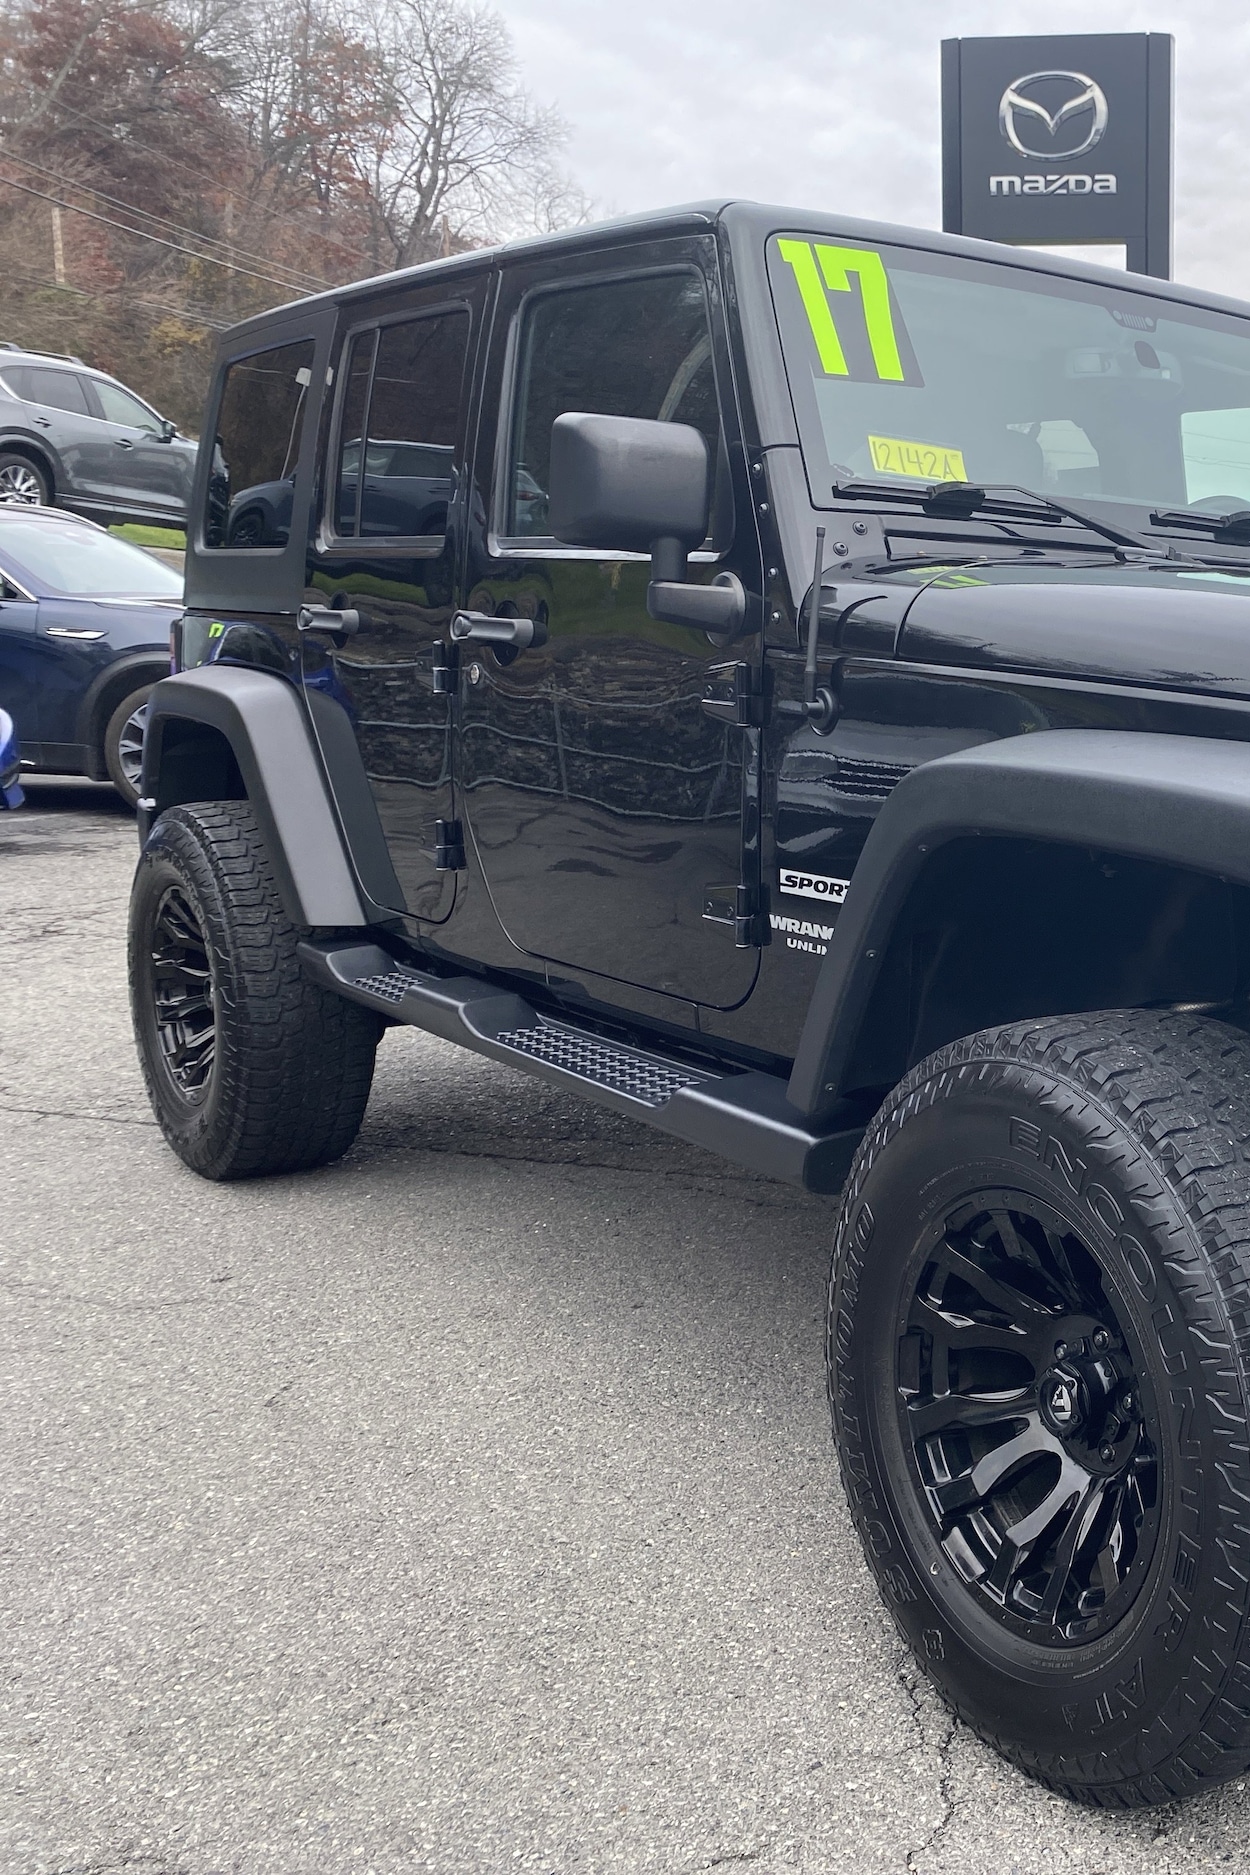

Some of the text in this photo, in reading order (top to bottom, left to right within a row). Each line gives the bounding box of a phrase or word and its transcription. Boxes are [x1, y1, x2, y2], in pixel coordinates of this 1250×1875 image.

[777, 238, 904, 381] 17
[872, 441, 959, 481] 12142A
[781, 874, 850, 897] SPOR
[836, 1202, 918, 1603] SUMITOMO
